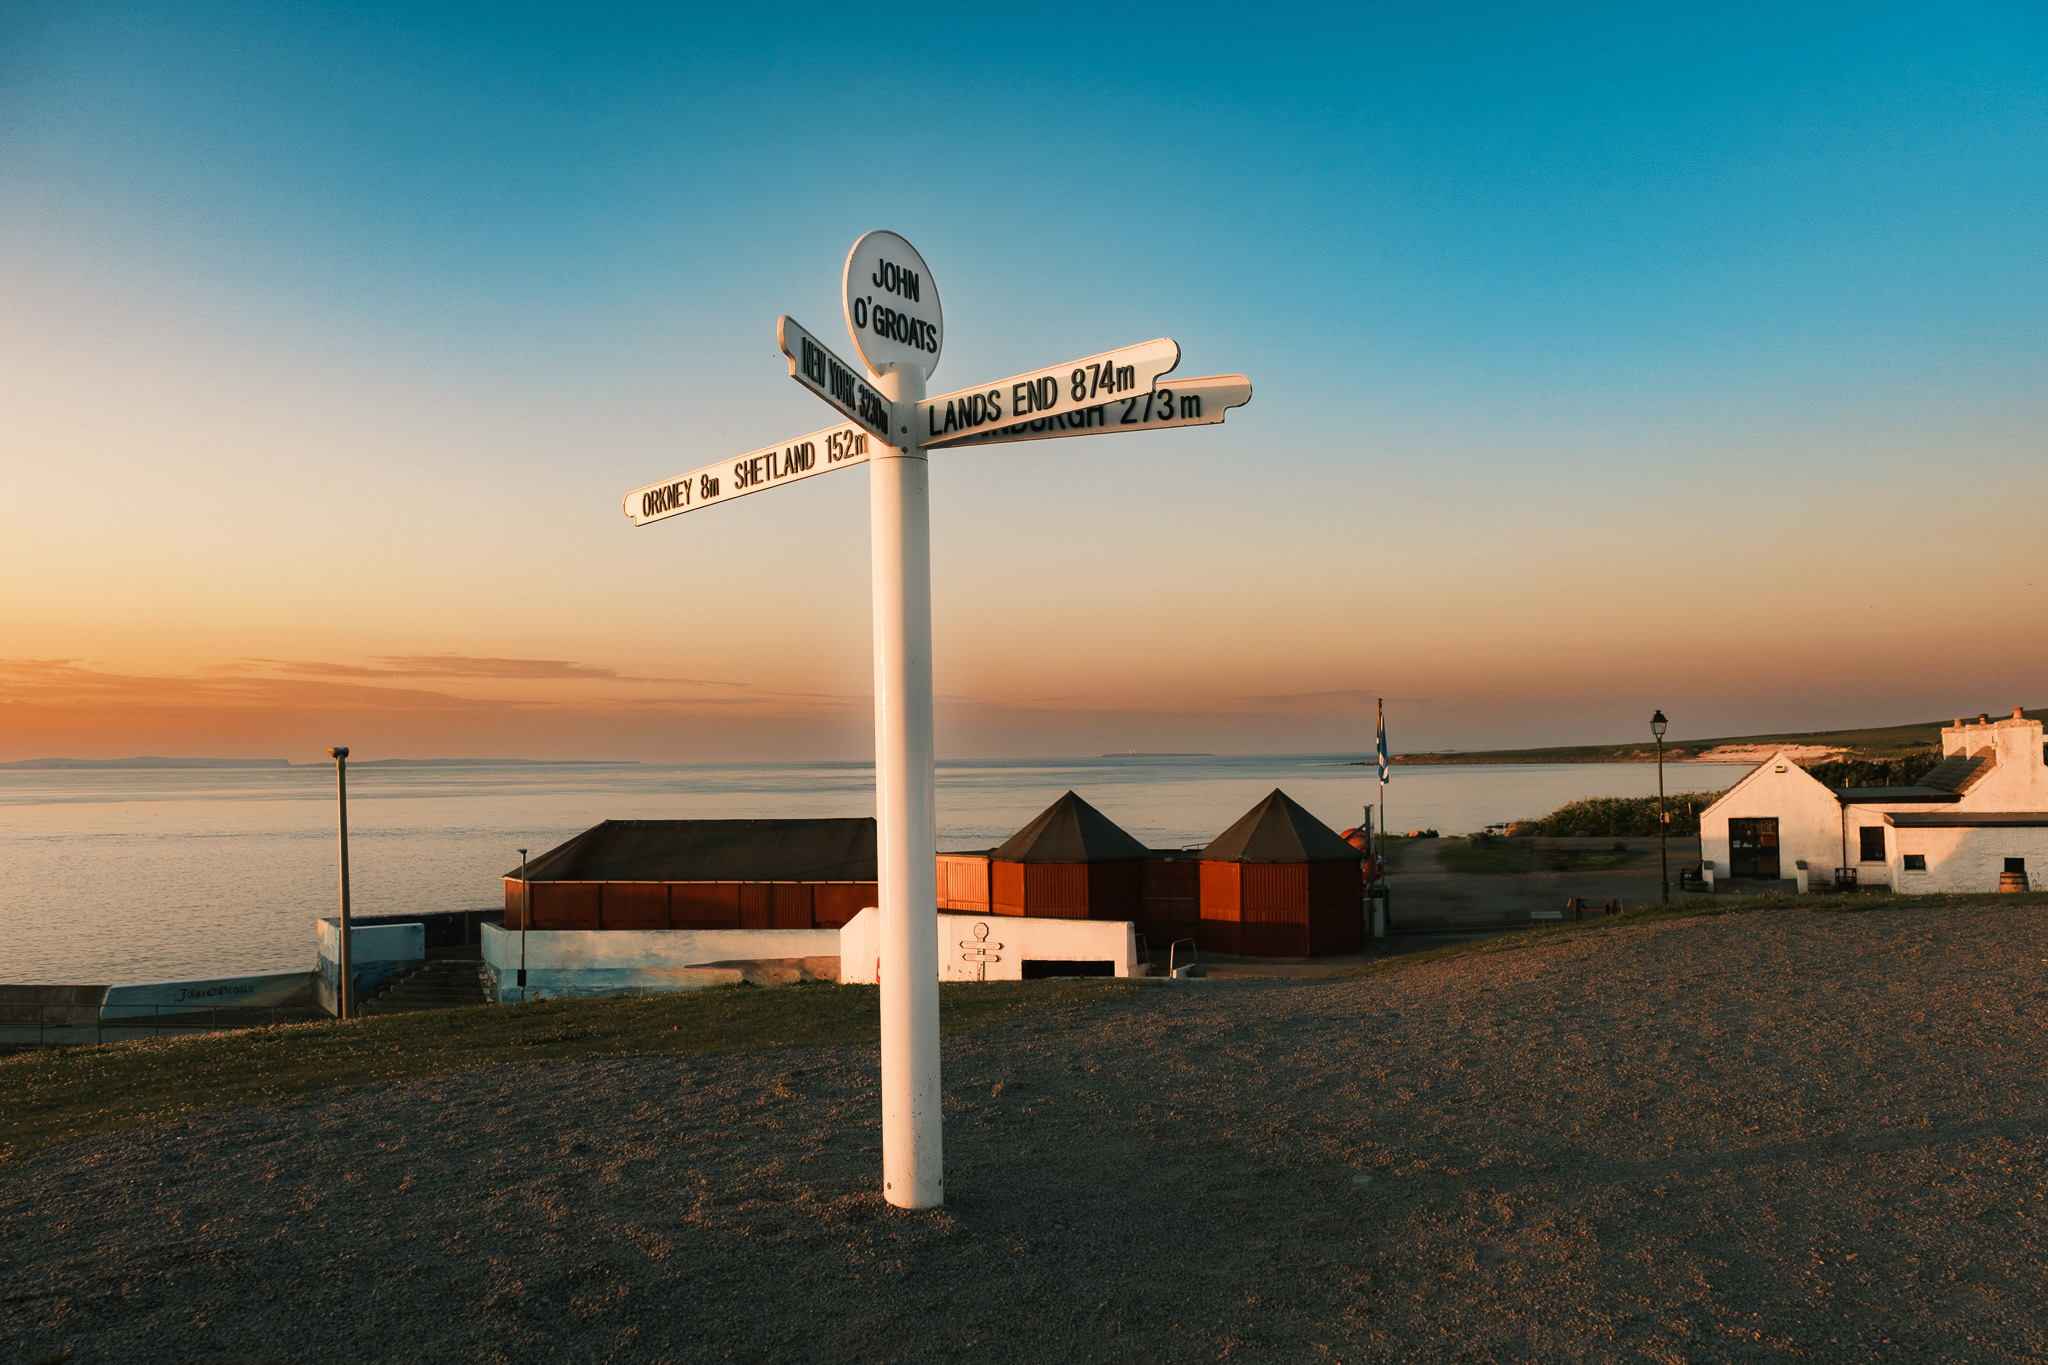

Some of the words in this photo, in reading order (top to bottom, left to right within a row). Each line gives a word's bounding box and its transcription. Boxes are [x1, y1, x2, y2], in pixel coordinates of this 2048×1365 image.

[873, 258, 919, 303] JOHN
[855, 296, 938, 353] O'GROATS
[802, 337, 826, 388] NEW
[827, 358, 856, 411] YORK
[857, 384, 888, 435] 3230m
[929, 389, 1001, 436] LANDS
[1012, 376, 1058, 416] END
[1071, 360, 1134, 402] 874m
[642, 478, 692, 517] ORKNEY
[700, 473, 720, 500] 8m
[734, 441, 815, 489] SHETLAND
[825, 429, 869, 463] 152m
